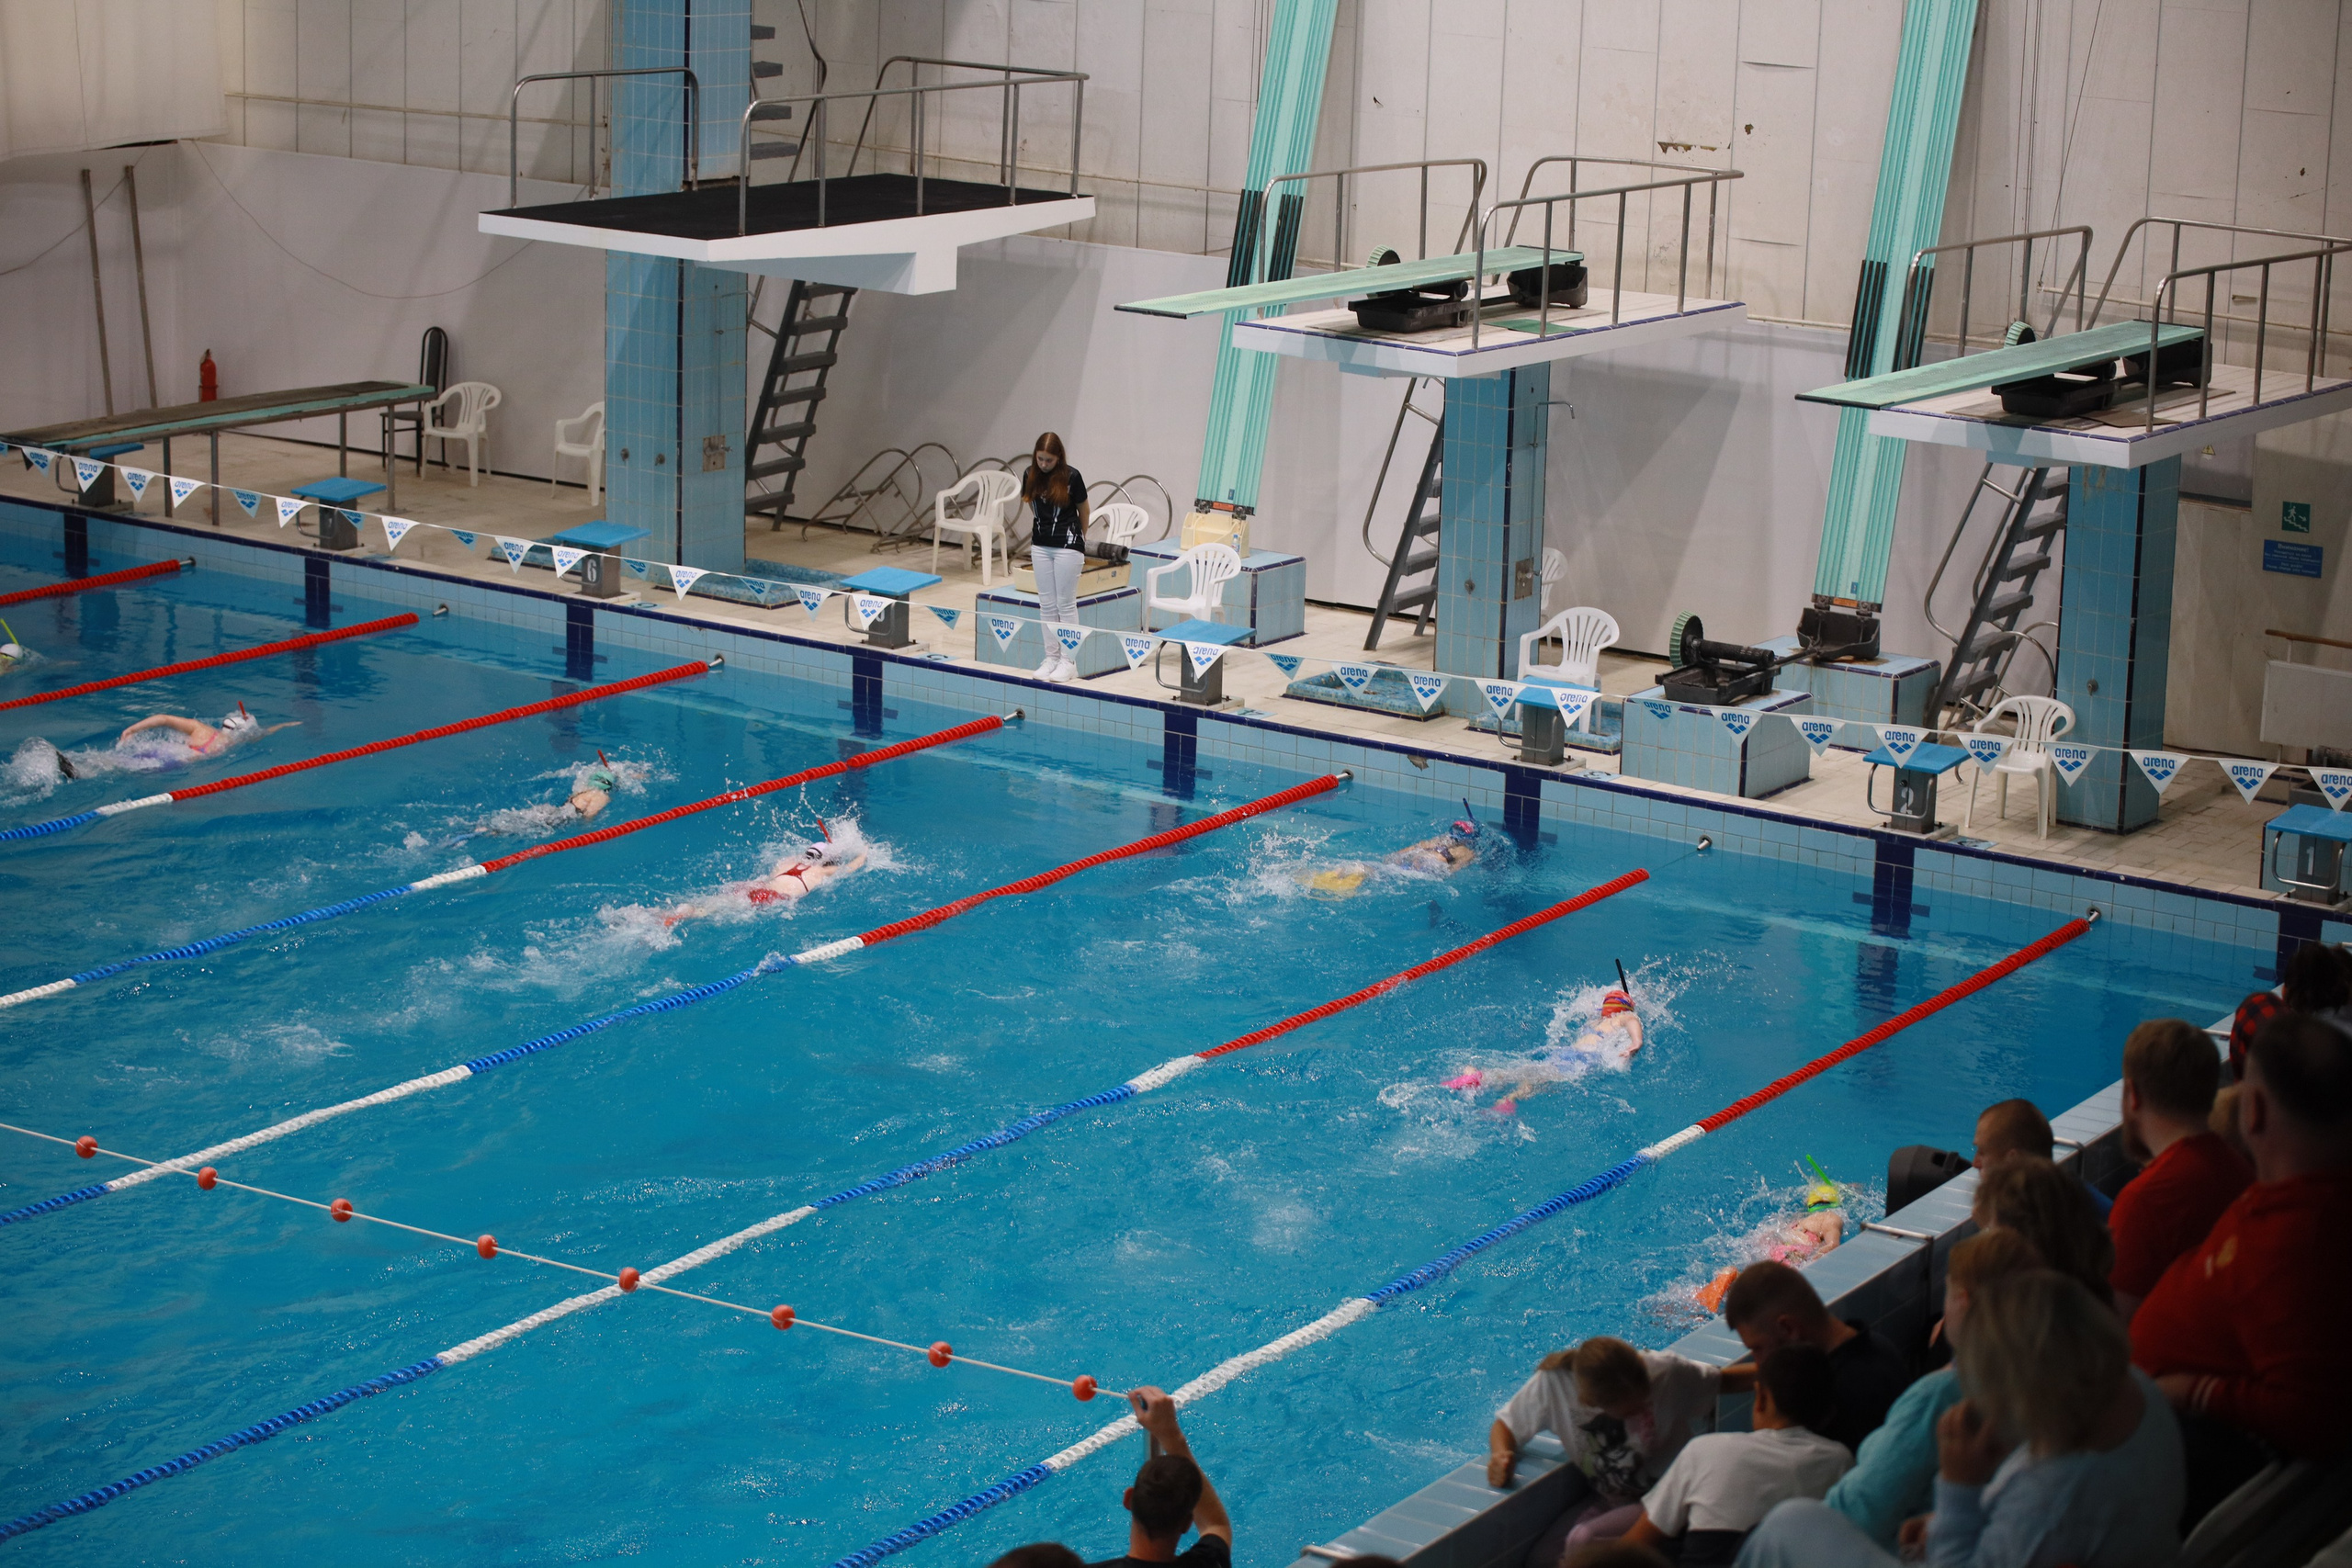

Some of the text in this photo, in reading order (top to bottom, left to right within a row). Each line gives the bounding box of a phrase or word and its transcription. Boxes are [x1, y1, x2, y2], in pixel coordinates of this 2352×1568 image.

[587, 558, 597, 582] 6
[799, 590, 820, 602] arena
[860, 599, 883, 609] arena
[991, 618, 1015, 630] arena
[1057, 628, 1081, 640] arena
[1125, 637, 1149, 649] arena
[1193, 646, 1218, 657] arena
[1271, 653, 1297, 663] arena
[1340, 666, 1368, 678] arena
[1413, 674, 1441, 687] arena
[1486, 684, 1513, 696] arena
[1559, 693, 1589, 704] arena
[1644, 701, 1671, 713] arena
[1721, 712, 1750, 725] arena
[1802, 721, 1832, 733] arena
[1884, 730, 1916, 742] arena
[1970, 739, 2001, 751] arena
[2055, 748, 2086, 760] arena
[2143, 757, 2175, 769] arena
[2232, 764, 2264, 777] arena
[2321, 773, 2352, 786] arena
[1900, 787, 1914, 815] 2
[2306, 846, 2314, 875] 1
